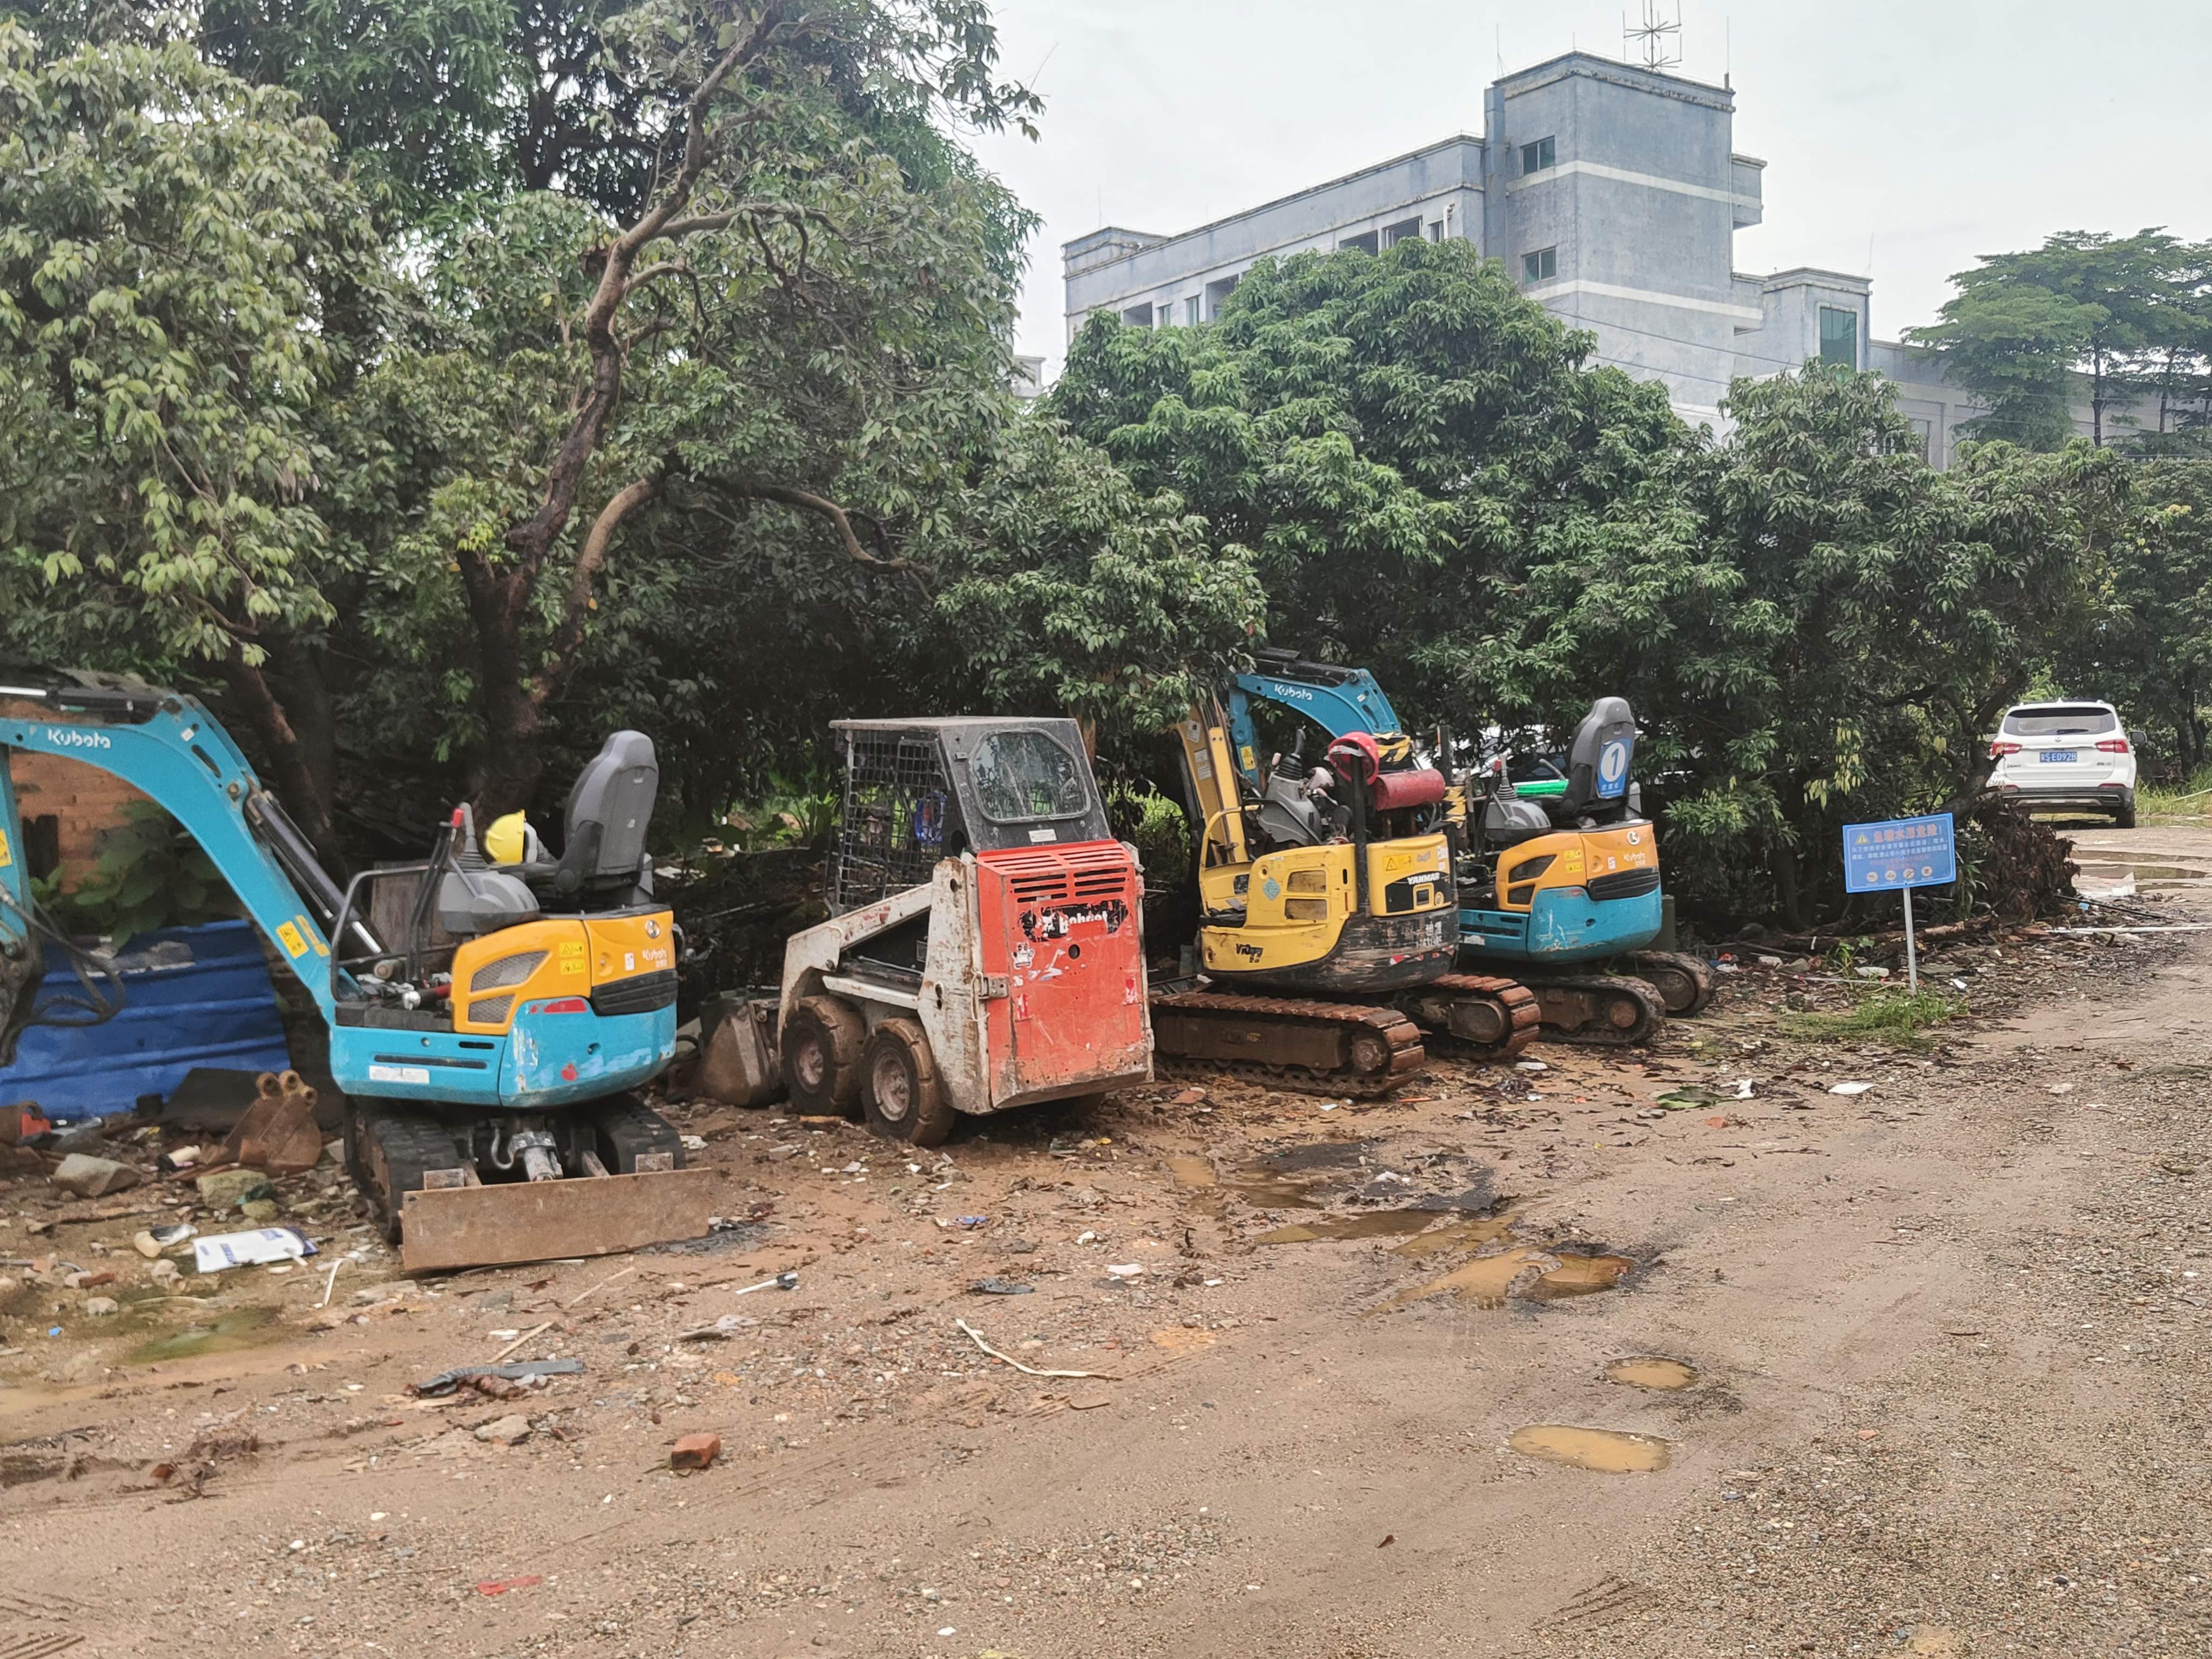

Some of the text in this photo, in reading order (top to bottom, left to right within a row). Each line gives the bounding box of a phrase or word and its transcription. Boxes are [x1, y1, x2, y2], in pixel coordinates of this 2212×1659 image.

[1274, 684, 1313, 701] Kubota
[47, 728, 111, 749] Kubota
[1407, 872, 1440, 886] YANMAR
